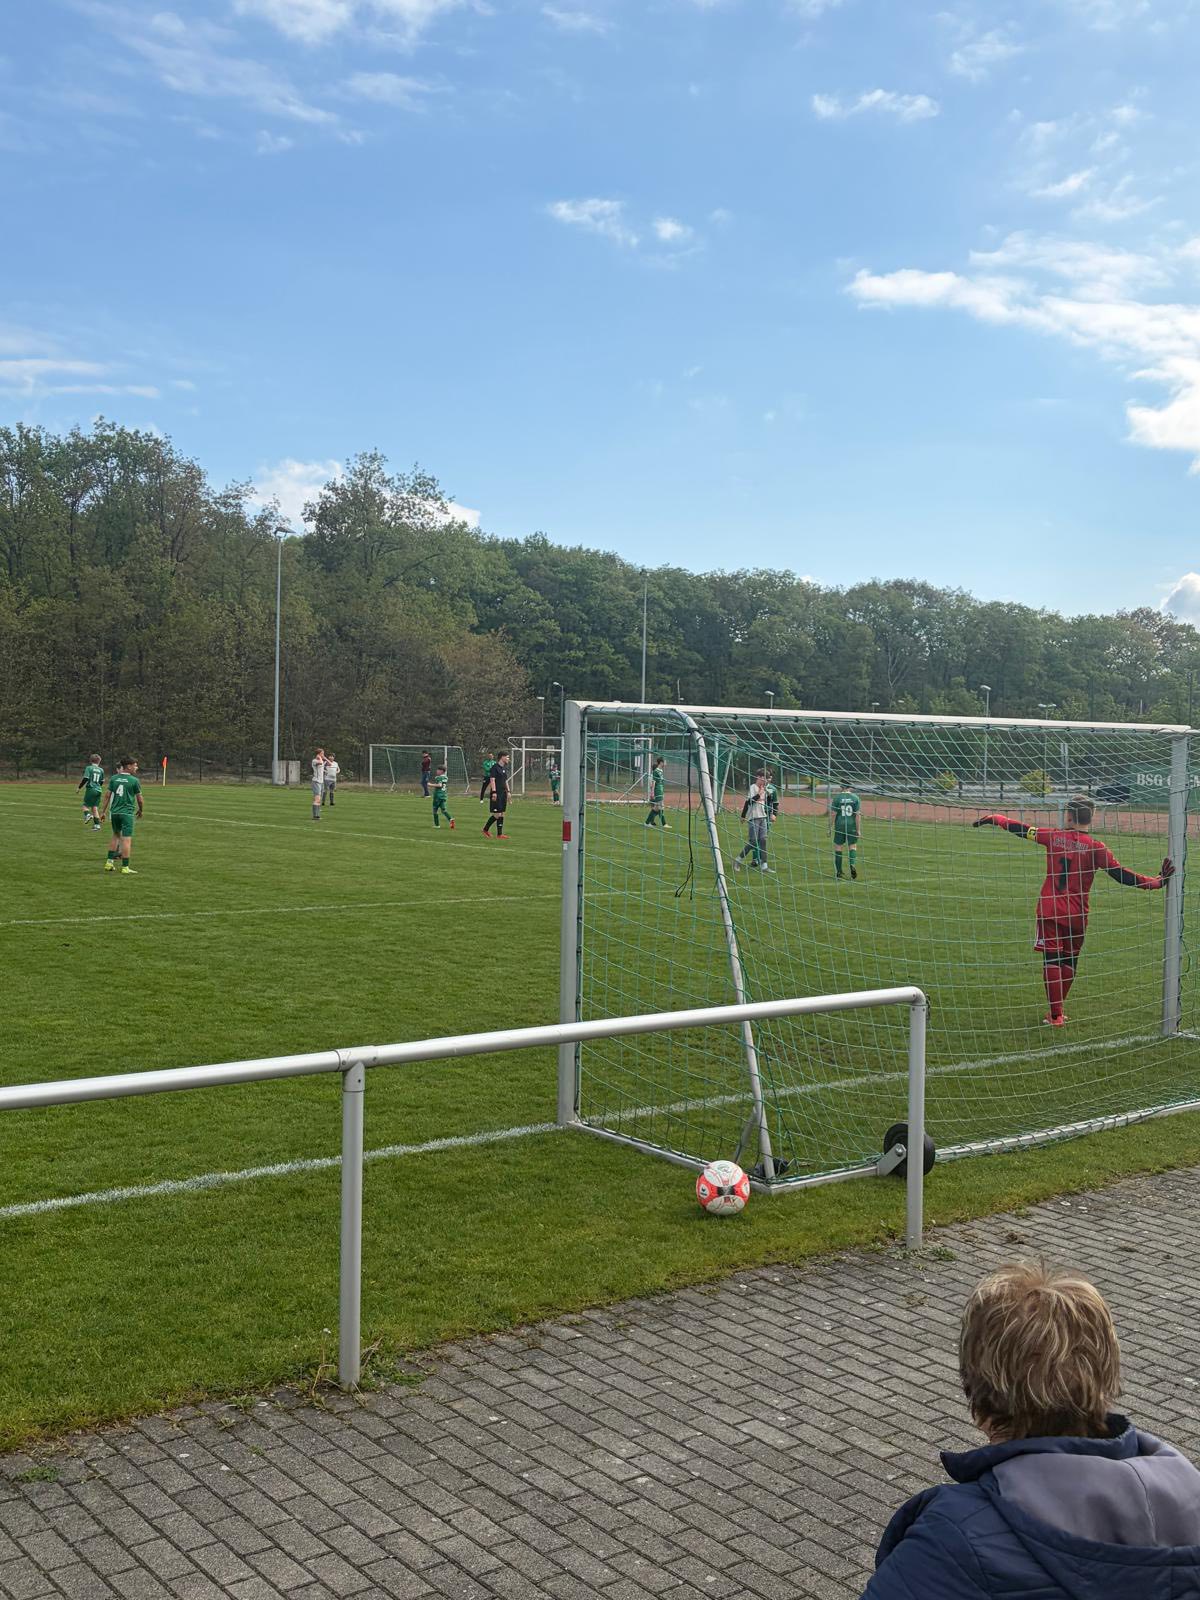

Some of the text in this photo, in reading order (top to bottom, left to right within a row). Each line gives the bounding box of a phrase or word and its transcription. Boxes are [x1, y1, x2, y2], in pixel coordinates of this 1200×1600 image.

[93, 773, 100, 783] 11
[1137, 773, 1163, 787] BSG
[116, 784, 124, 797] 4
[841, 804, 853, 817] 10
[1058, 856, 1072, 891] 1
